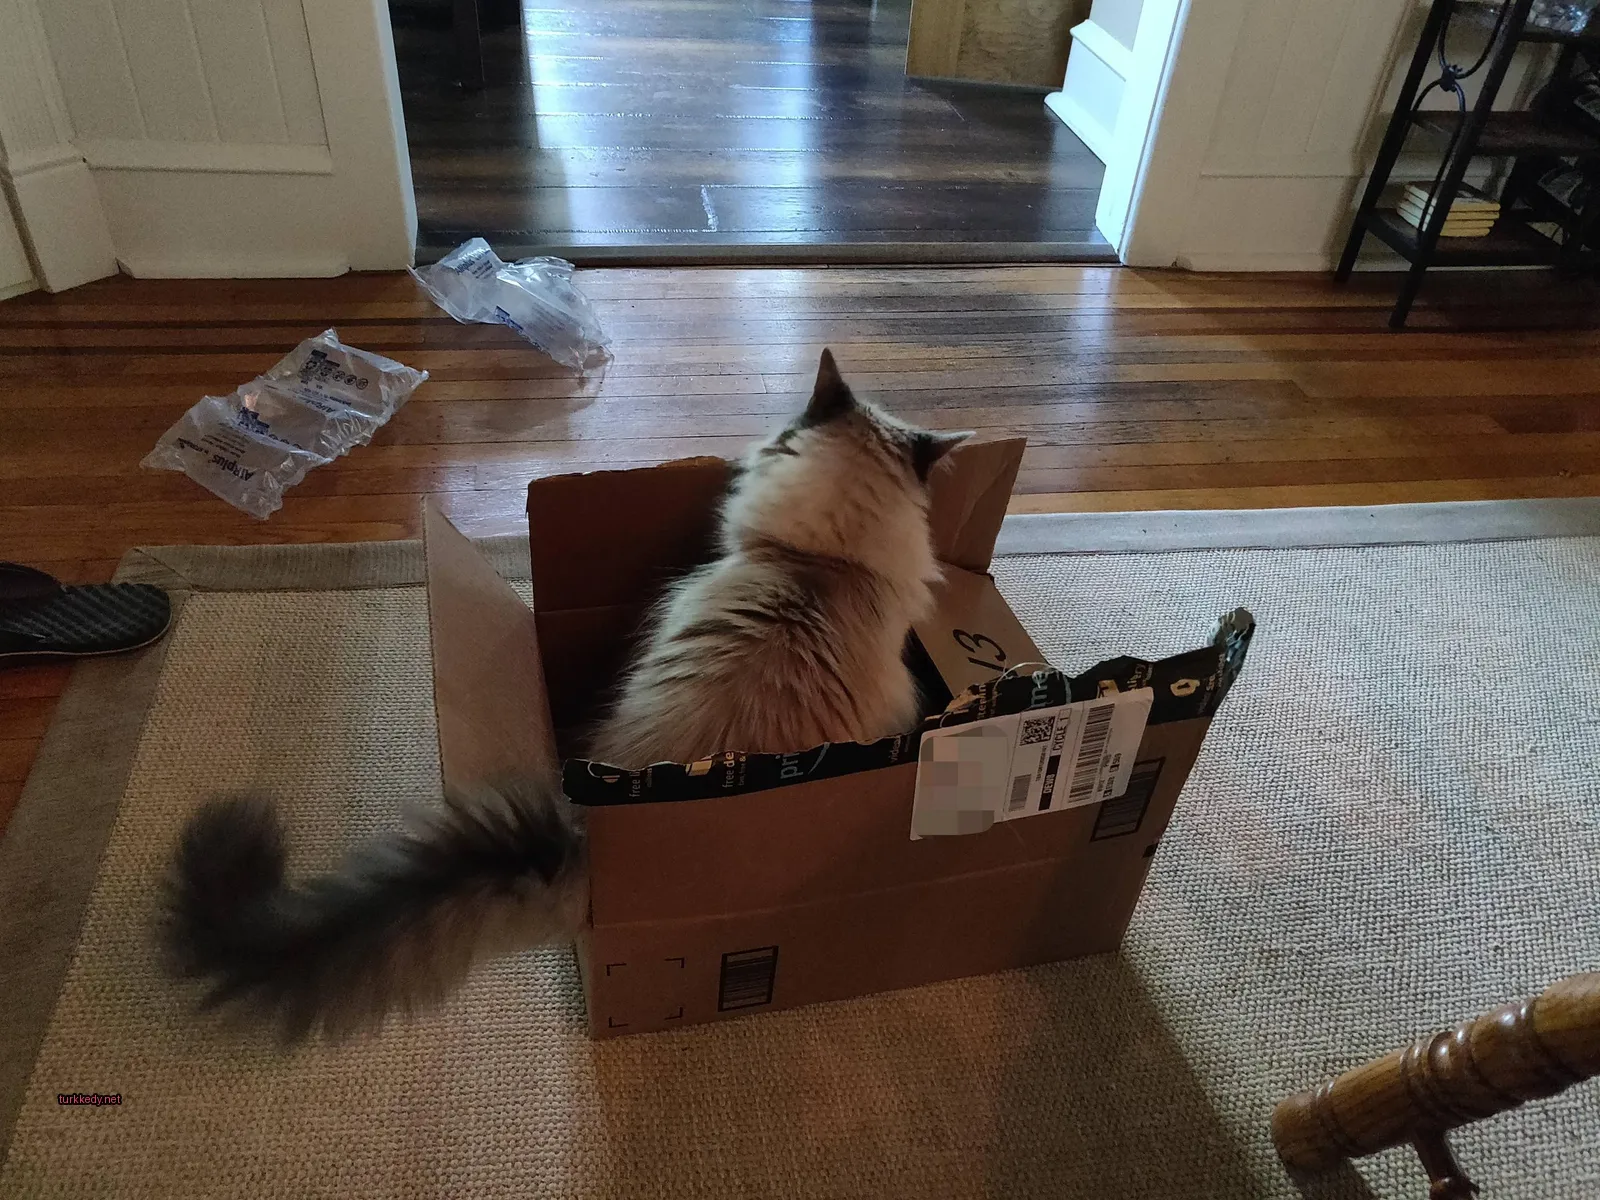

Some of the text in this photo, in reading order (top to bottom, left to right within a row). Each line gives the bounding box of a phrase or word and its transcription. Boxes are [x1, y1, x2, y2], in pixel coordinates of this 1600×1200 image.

[211, 454, 254, 481] AIRplus
[952, 629, 1018, 678] 13
[1052, 726, 1067, 751] CYCLE
[722, 751, 736, 788] free de
[775, 752, 804, 780] pri
[628, 779, 641, 798] free
